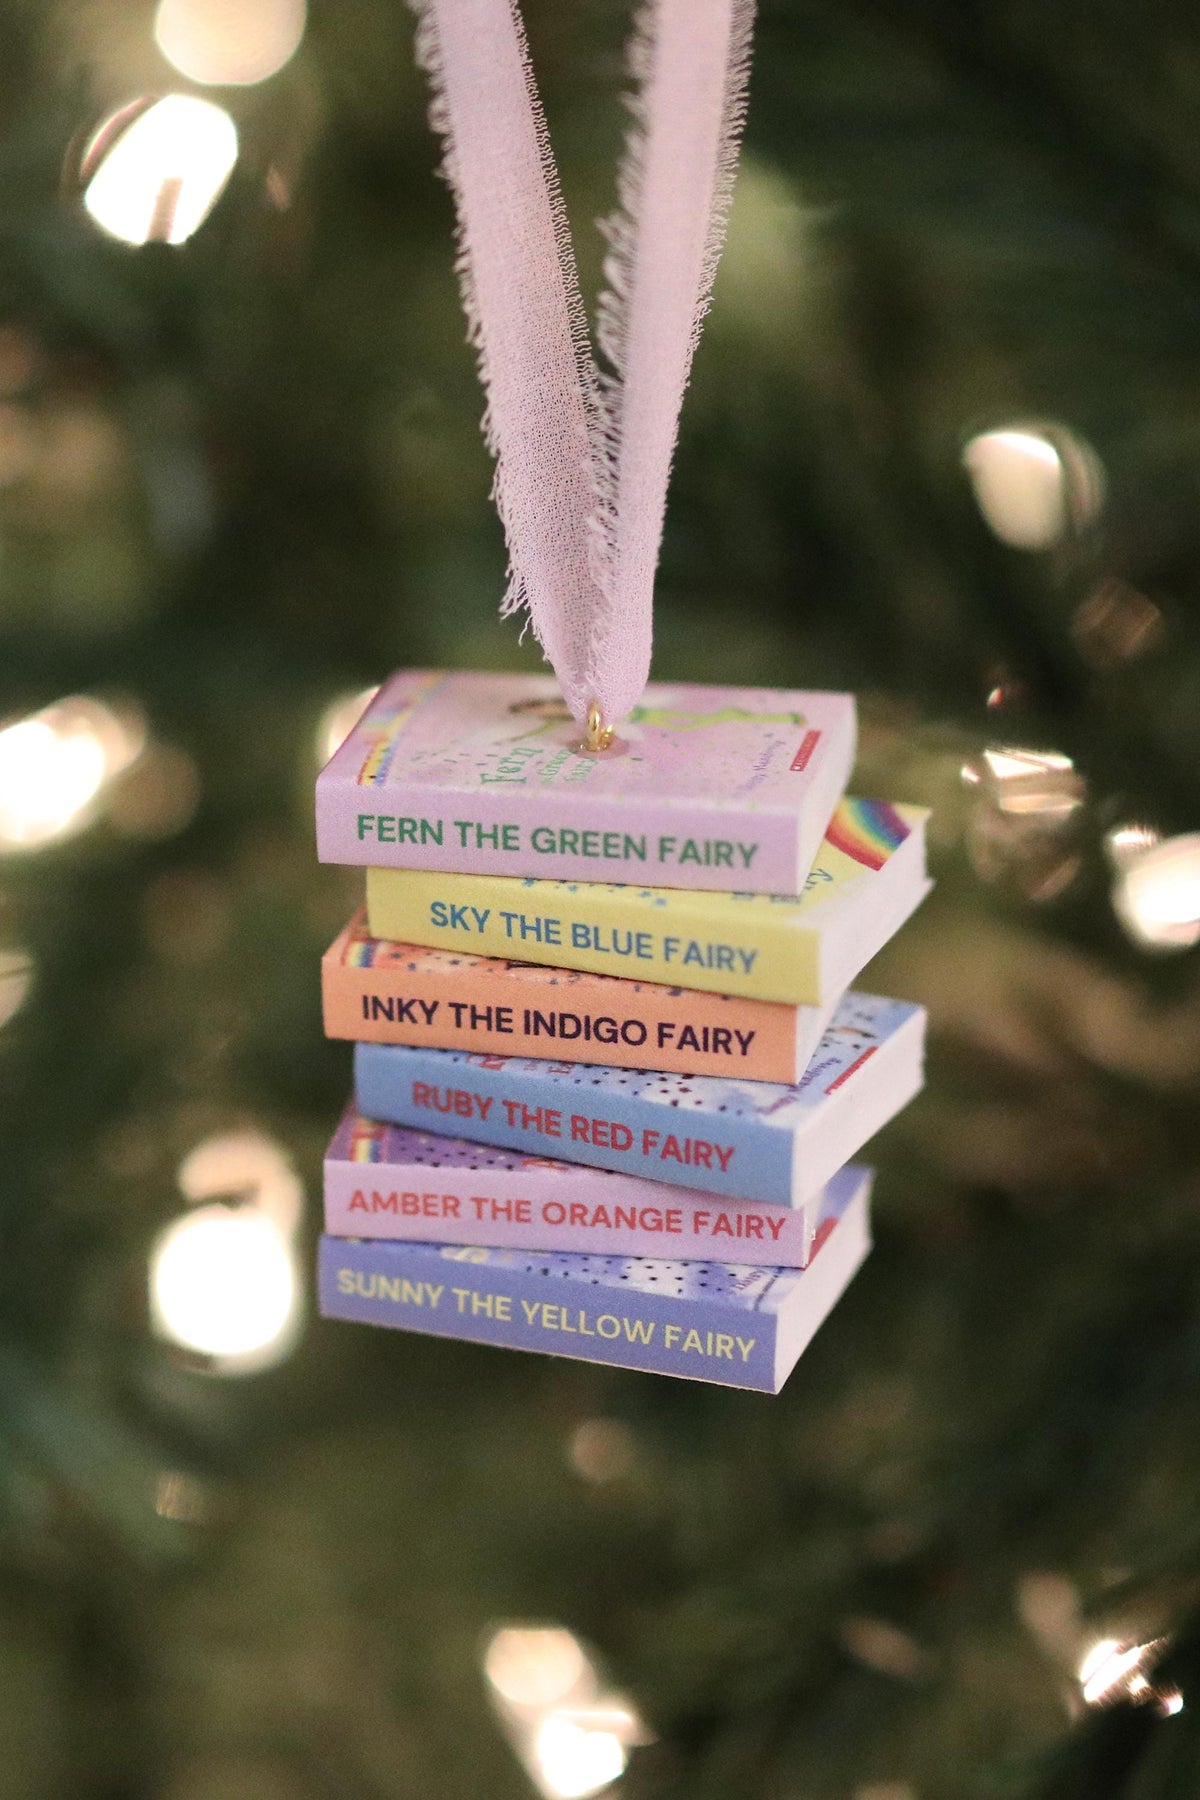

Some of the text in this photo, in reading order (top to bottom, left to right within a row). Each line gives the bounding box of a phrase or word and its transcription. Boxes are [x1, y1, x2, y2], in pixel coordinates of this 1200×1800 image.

[480, 747, 544, 784] Fern
[358, 815, 757, 867] FERN THE GREEN FAIRY
[431, 902, 756, 973] SKY THE BLUE FAIRY
[363, 996, 755, 1056] INKY THE INDIGO FAIRY
[413, 1082, 493, 1120] RUBY
[502, 1100, 561, 1136] THE
[571, 1115, 633, 1151] RED
[643, 1130, 734, 1172] FAIRY
[349, 1191, 785, 1239] AMBER THE ORANGE FAIRY
[338, 1269, 755, 1361] SUNNY THE YELLOW FAIRY
